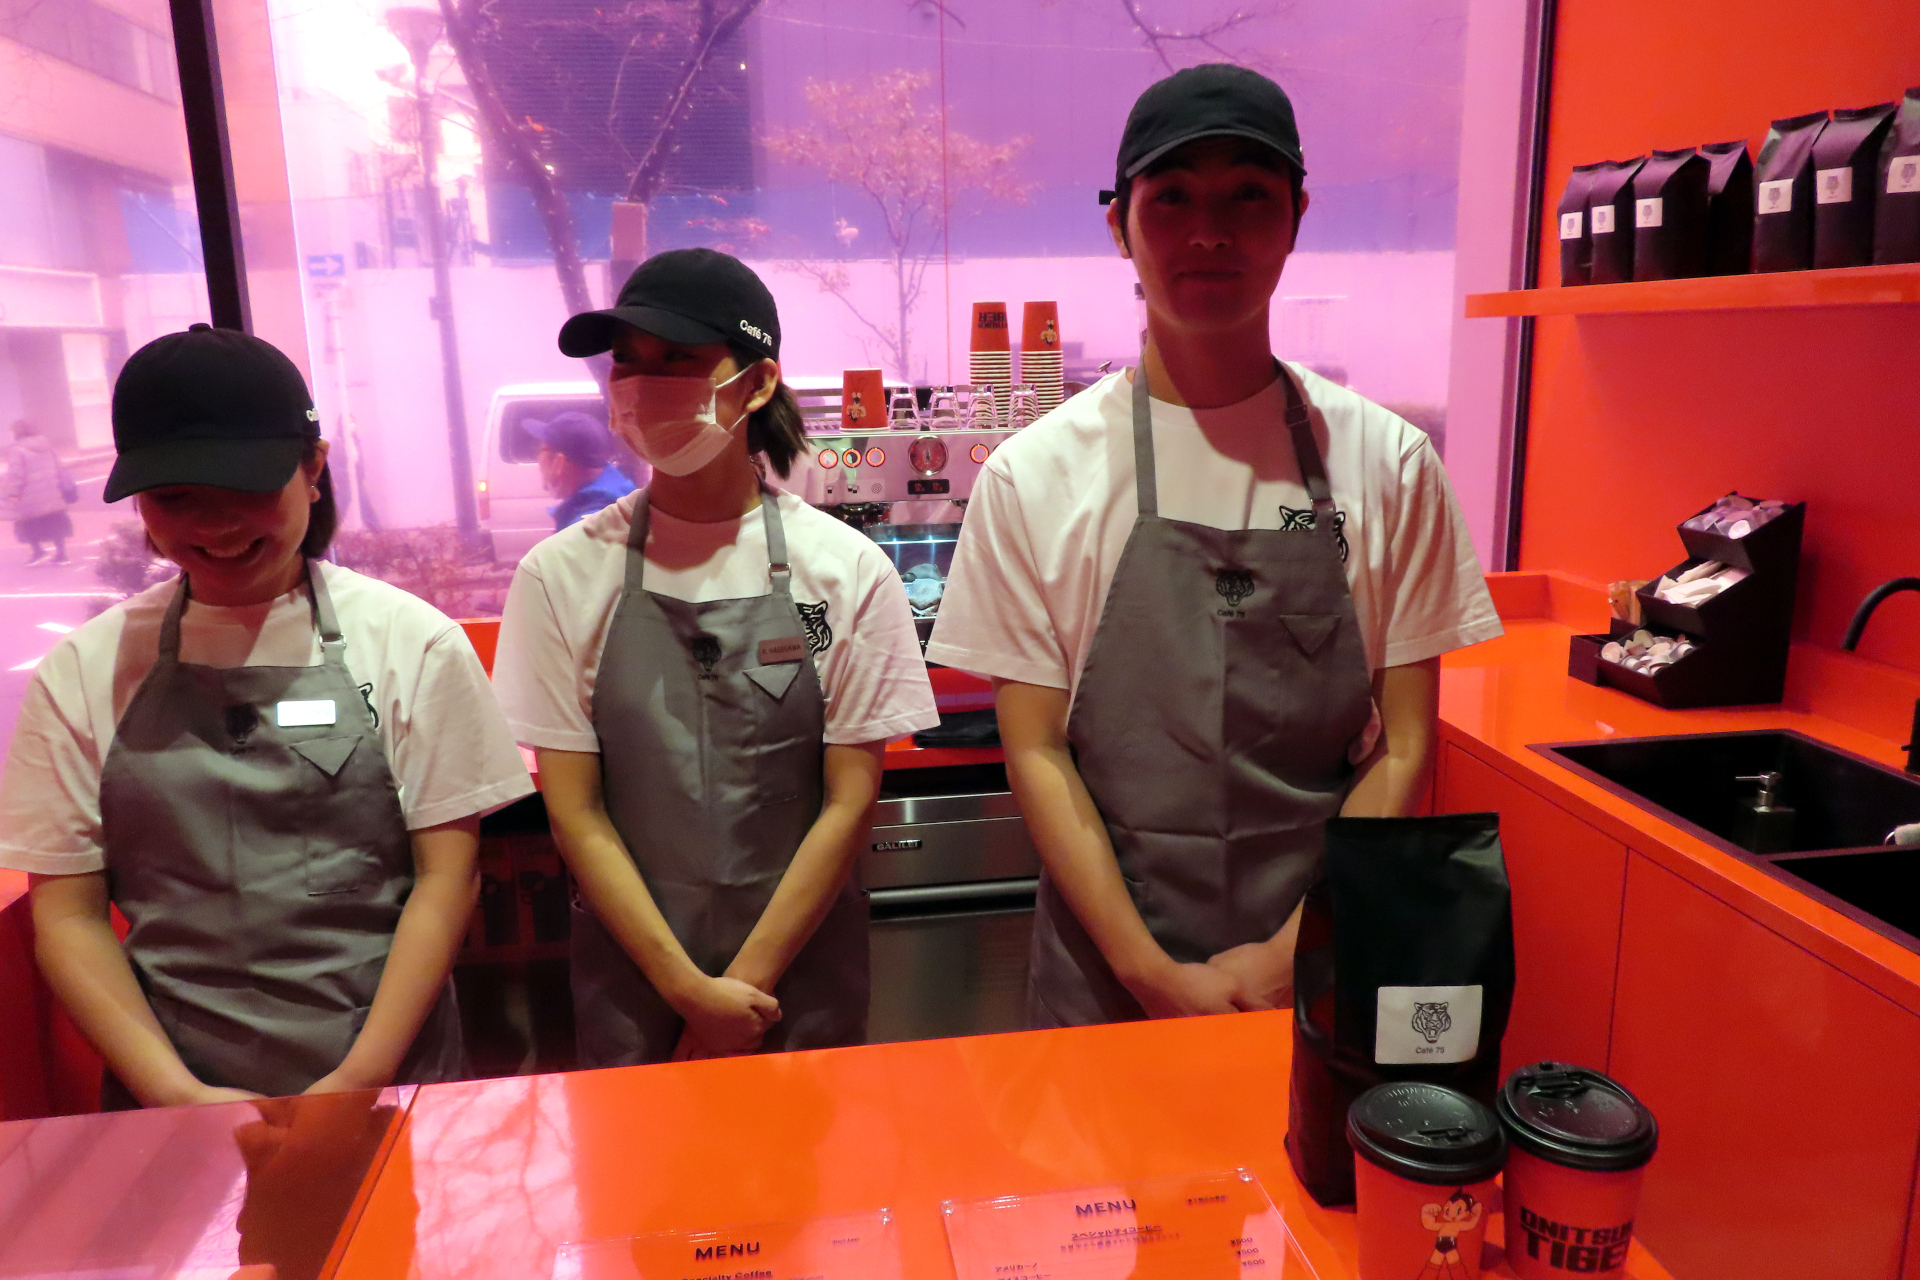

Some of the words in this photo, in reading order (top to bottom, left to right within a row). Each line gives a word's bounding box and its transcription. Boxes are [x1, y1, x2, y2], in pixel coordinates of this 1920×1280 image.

[740, 319, 761, 340] Café
[762, 332, 773, 346] 75
[876, 840, 919, 851] GALILEI
[1415, 1046, 1434, 1054] Café
[1436, 1046, 1445, 1054] 75
[1074, 1198, 1137, 1217] MENU
[694, 1241, 761, 1261] MENU
[734, 1269, 772, 1279] Coffee
